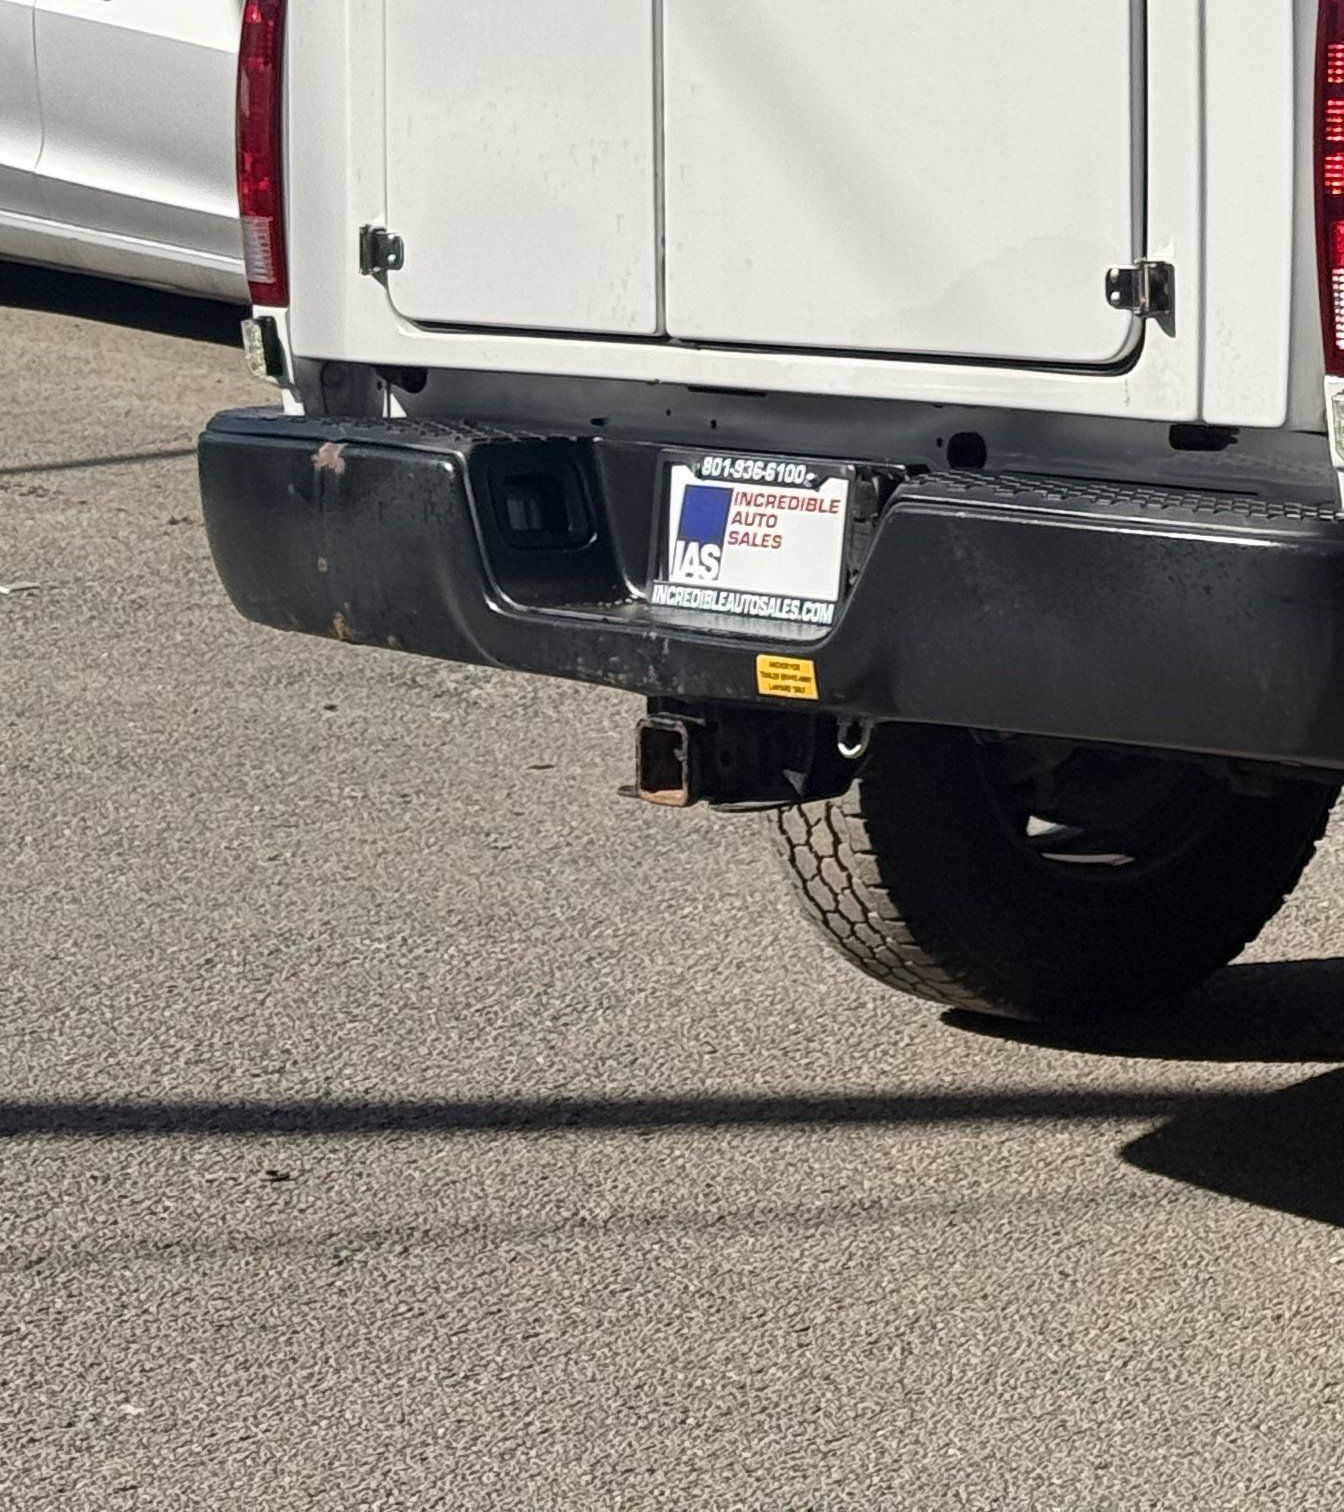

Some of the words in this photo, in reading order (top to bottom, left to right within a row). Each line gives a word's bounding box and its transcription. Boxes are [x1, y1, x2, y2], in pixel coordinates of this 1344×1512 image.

[702, 457, 805, 484] 801-936-6100
[734, 492, 840, 513] INCREDIBLE
[731, 511, 777, 527] AUTO
[727, 530, 783, 549] SALES
[673, 541, 720, 580] IAS
[652, 584, 835, 624] INCREDIBLEAUTOSALES.COM
